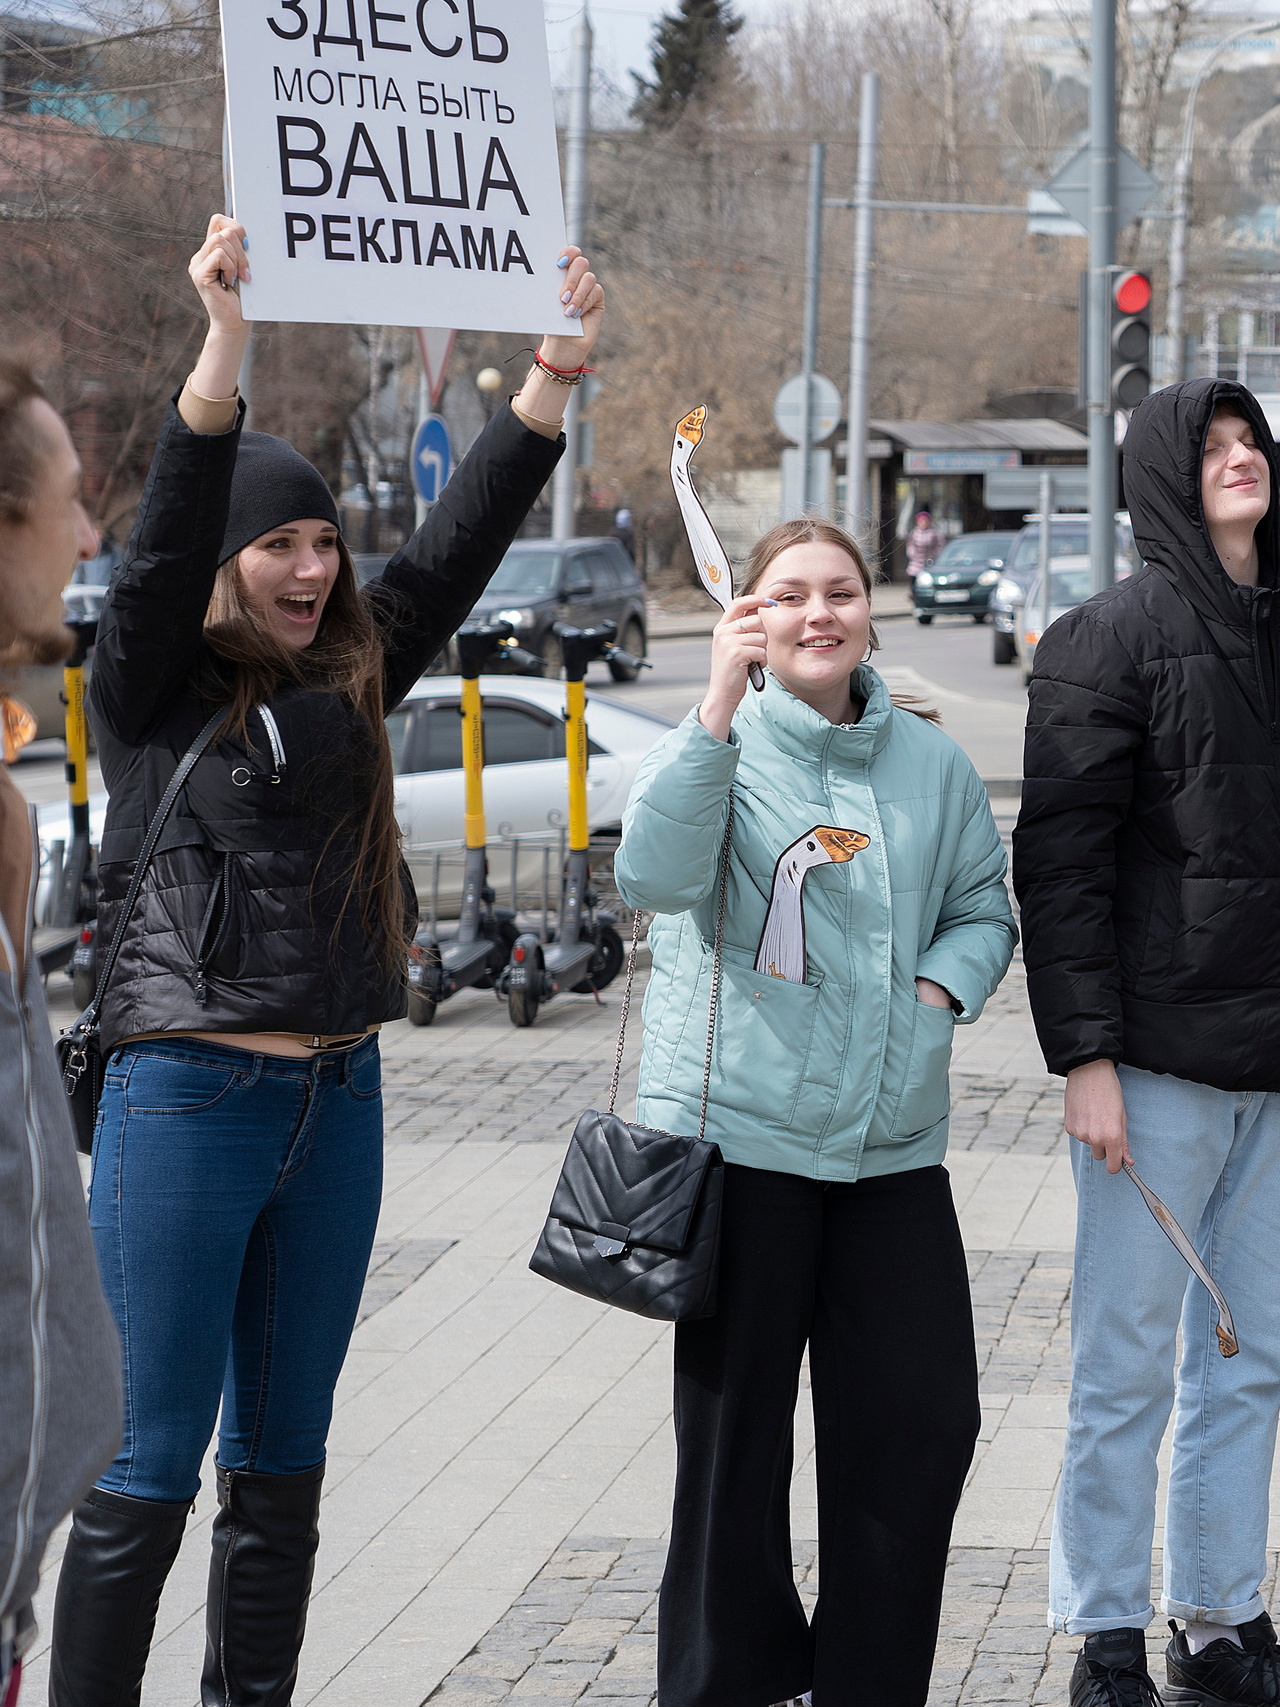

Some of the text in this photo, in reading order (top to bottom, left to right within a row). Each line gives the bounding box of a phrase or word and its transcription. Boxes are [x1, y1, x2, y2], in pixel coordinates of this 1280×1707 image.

[266, 0, 509, 64] ЗДЕСЬ
[273, 65, 515, 125] МОГЛА БЫТЬ
[276, 114, 531, 217] ВАША
[284, 211, 535, 276] РЕКЛАМА
